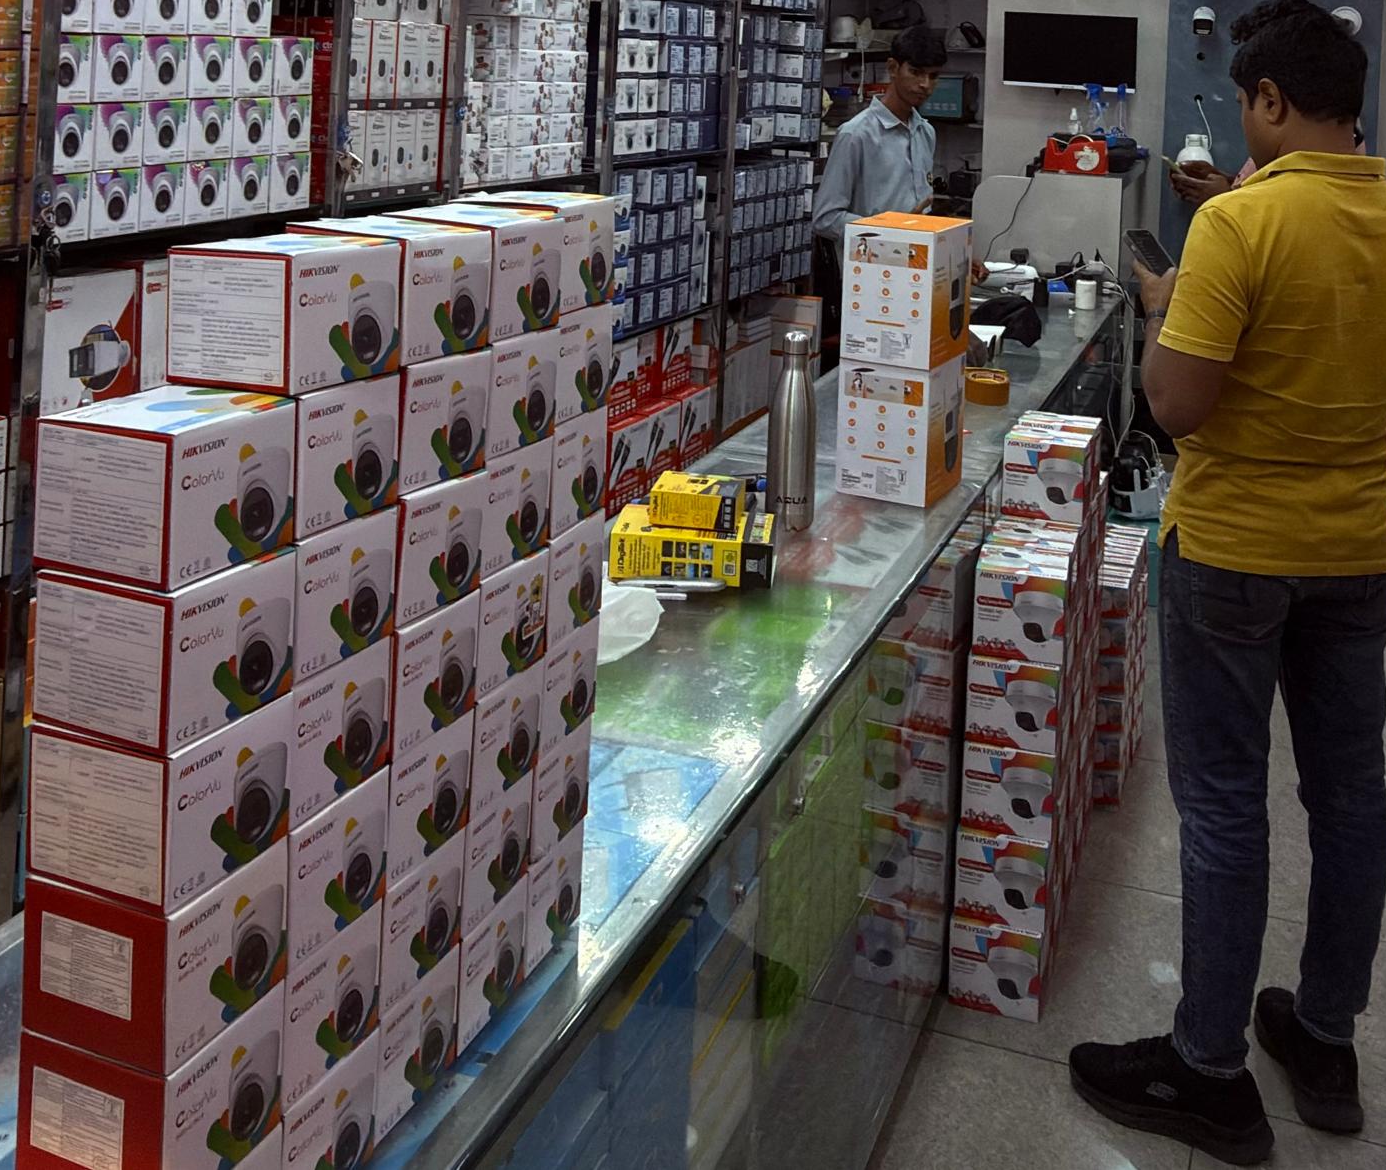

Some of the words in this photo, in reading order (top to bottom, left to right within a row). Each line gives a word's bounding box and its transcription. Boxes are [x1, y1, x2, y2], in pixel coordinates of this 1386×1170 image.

[299, 265, 340, 278] HIKVISION
[299, 293, 337, 307] ColorVu
[308, 403, 345, 420] HIKVISION
[182, 437, 229, 459] HIKVISION
[308, 432, 343, 449] ColorVu
[180, 466, 225, 491] ColorVu
[305, 543, 343, 566] HIKVISION
[303, 572, 340, 594] ColorVu
[980, 571, 1020, 582] HIKVISION
[181, 594, 229, 621] HIKVISION
[180, 626, 224, 652] ColorVu
[298, 681, 335, 709] HIKVISION
[297, 710, 333, 737] ColorVu
[180, 746, 225, 779] HIKVISION
[177, 780, 222, 810] ColorVu
[298, 820, 337, 852] HIKVISION
[179, 900, 223, 939] HIKVISION
